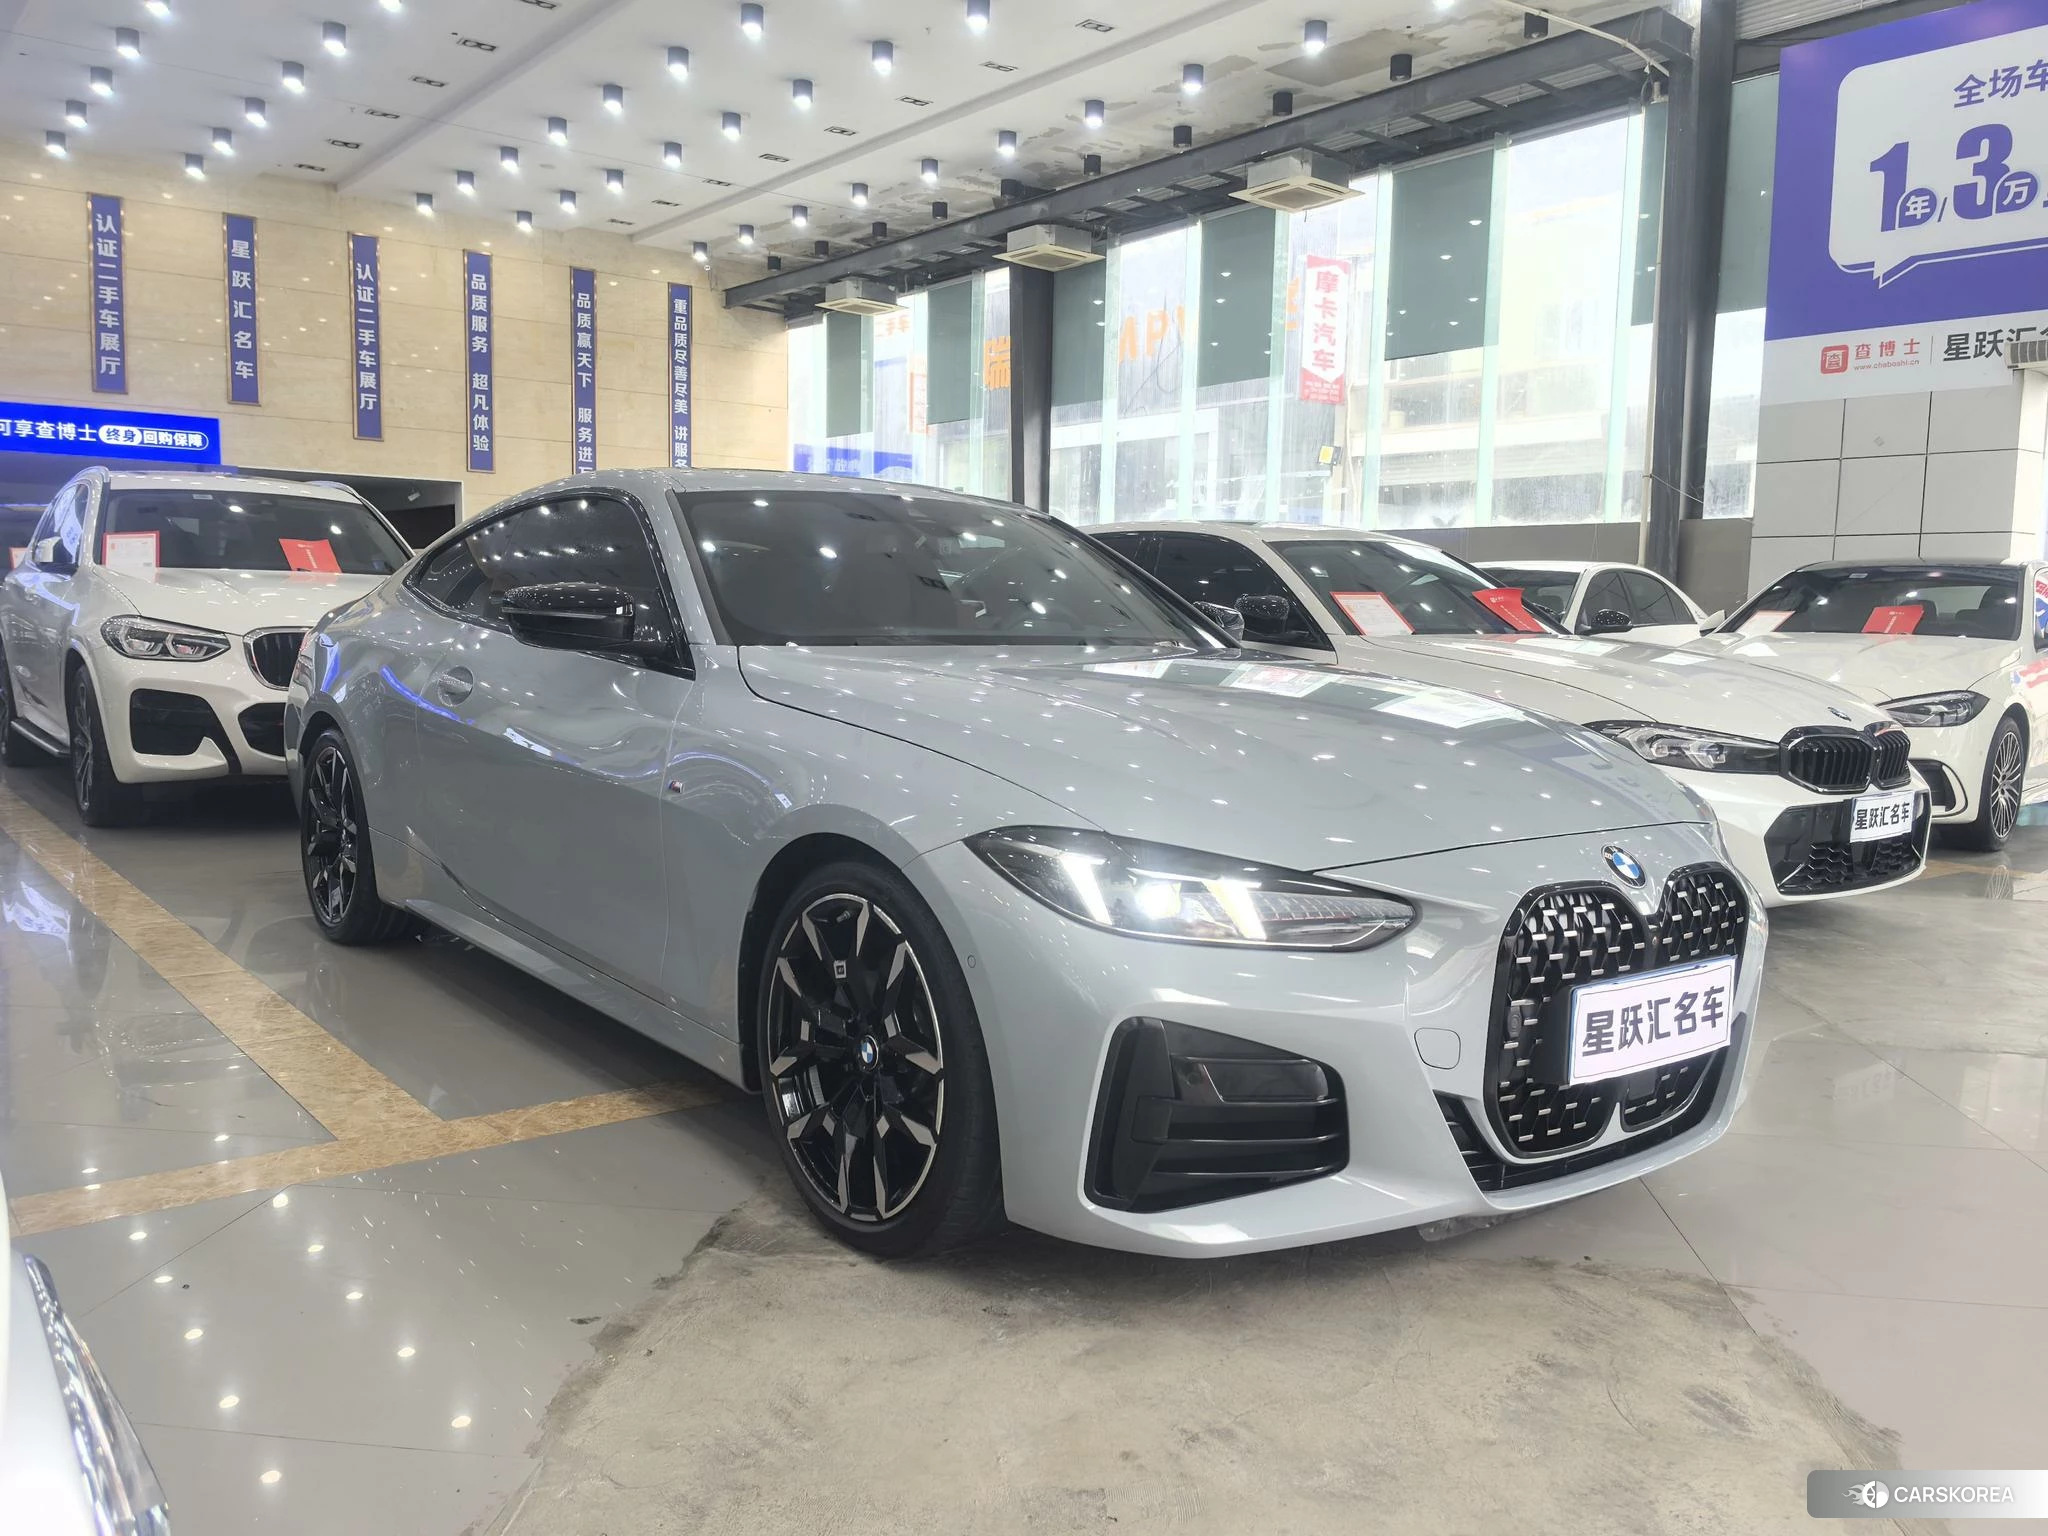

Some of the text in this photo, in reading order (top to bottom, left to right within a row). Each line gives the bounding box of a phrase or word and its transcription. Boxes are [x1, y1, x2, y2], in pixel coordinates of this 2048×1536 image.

[1953, 59, 2048, 108] 全场车
[95, 213, 121, 376] 认证二手车展厅
[231, 239, 254, 379] 星跃汇名车
[356, 262, 377, 410] 认证二手车展厅
[577, 293, 592, 388] 品质赢天下
[1855, 338, 1920, 360] 查博士
[1943, 327, 2048, 361] 星跃
[471, 274, 489, 452] 品质服务 超凡体验
[673, 299, 688, 414] 重品质尽善尽美
[1855, 802, 1910, 831] 星跃汇名车
[1582, 986, 1725, 1058] 星跃汇名车
